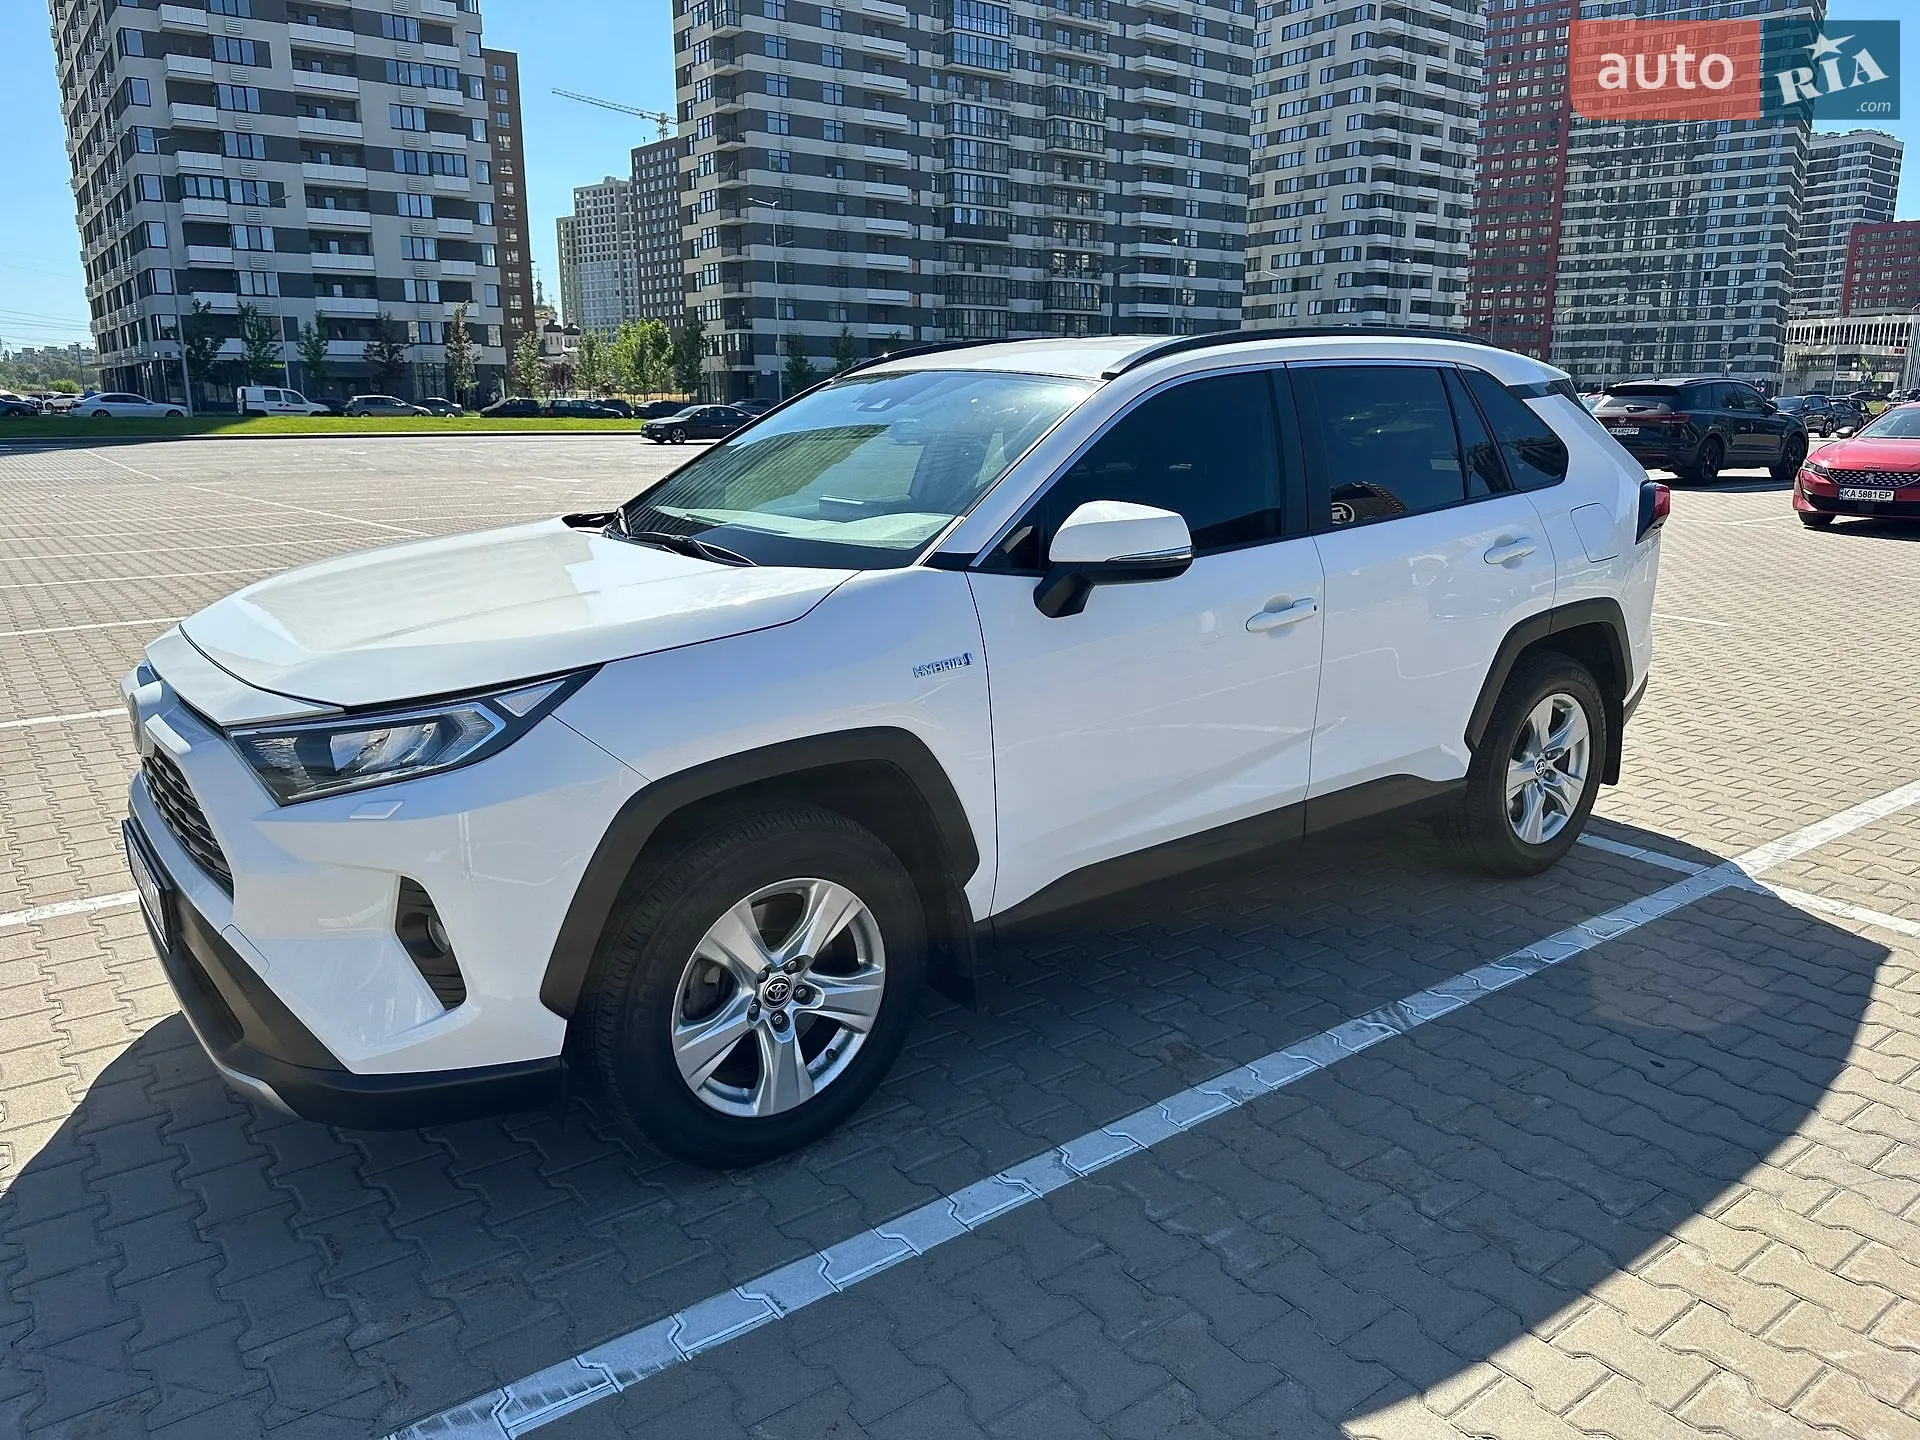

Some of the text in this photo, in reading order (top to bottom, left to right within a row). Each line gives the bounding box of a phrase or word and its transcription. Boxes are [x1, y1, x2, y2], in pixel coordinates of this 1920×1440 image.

[1844, 489, 1892, 500] KA 5881 EP
